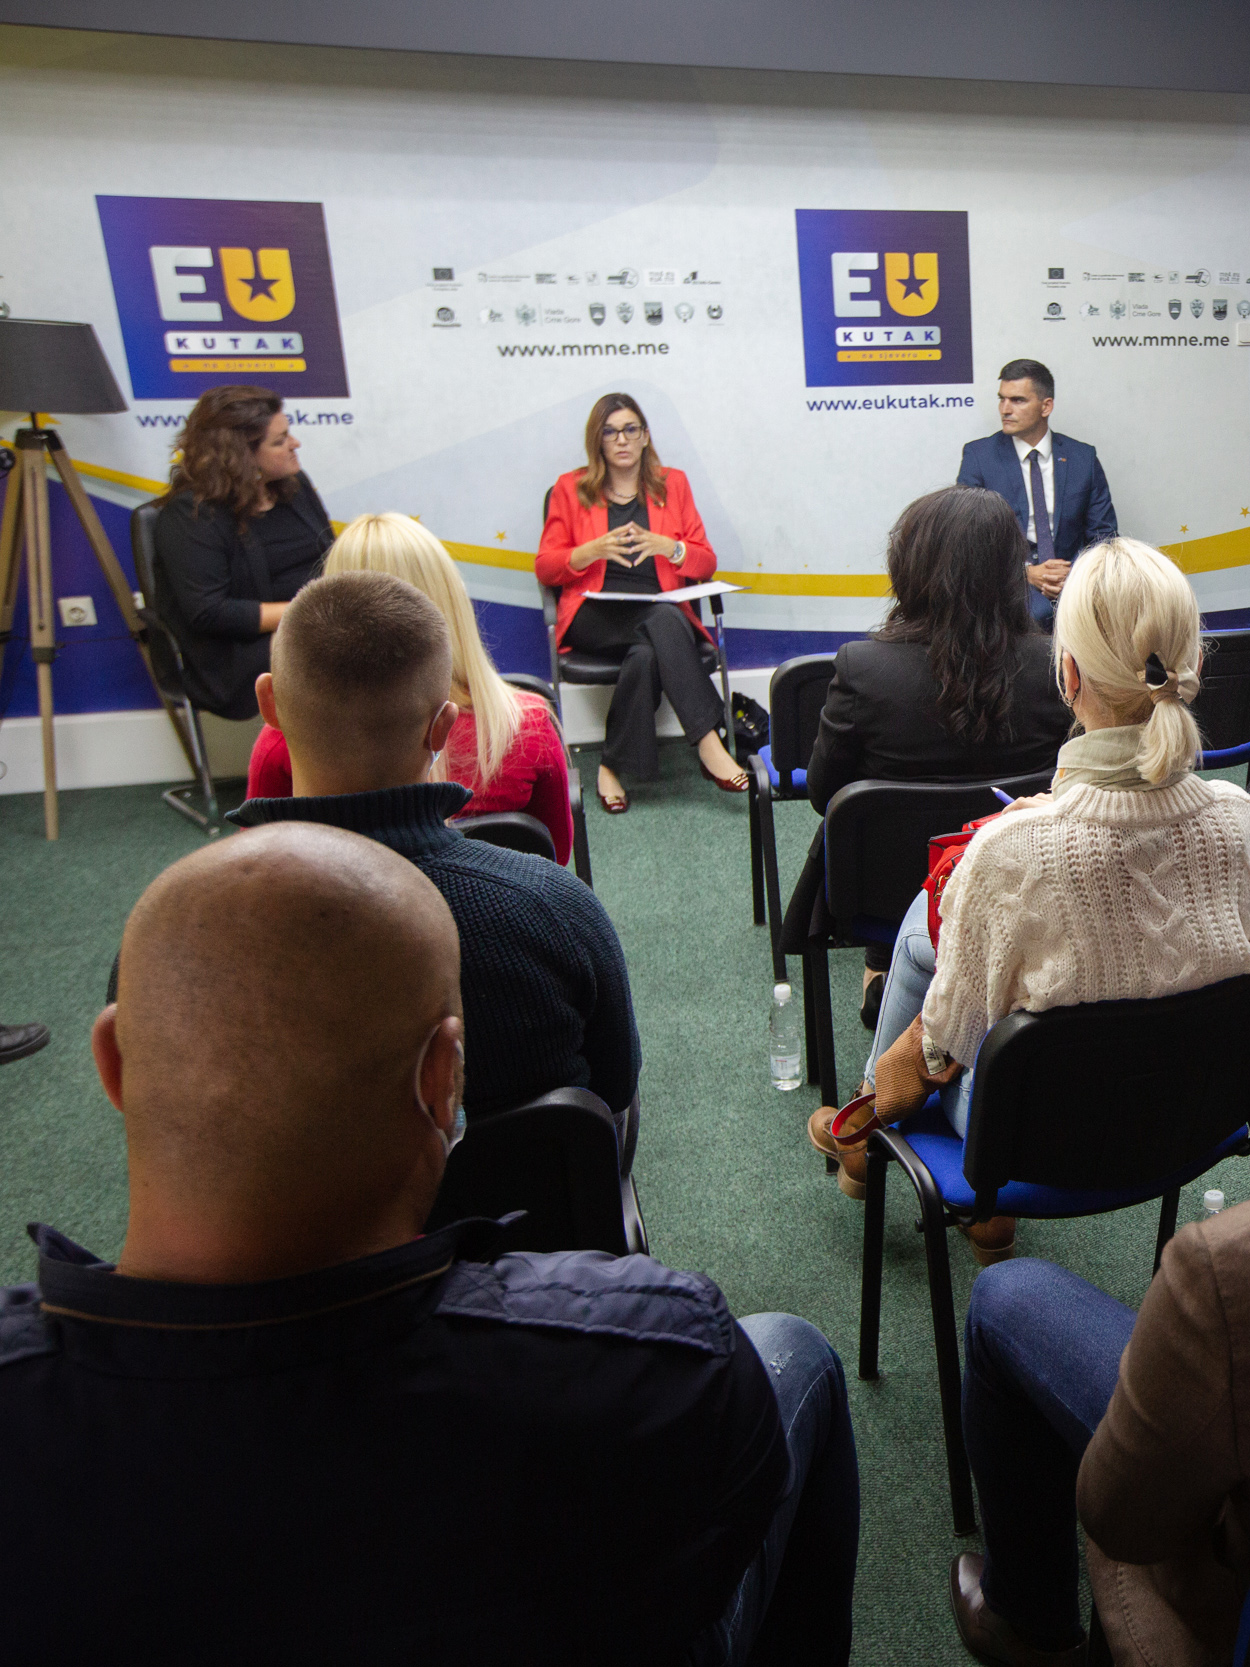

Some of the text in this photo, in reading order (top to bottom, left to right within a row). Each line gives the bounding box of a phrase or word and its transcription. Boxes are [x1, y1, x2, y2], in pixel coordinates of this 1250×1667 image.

[149, 246, 296, 322] EU
[831, 252, 940, 318] EU
[176, 337, 295, 350] KUTAK
[843, 331, 934, 342] KUTAK
[1092, 335, 1230, 347] www.mmne.me
[497, 343, 670, 357] www.mmne.me
[806, 395, 975, 411] www.eukutak.me
